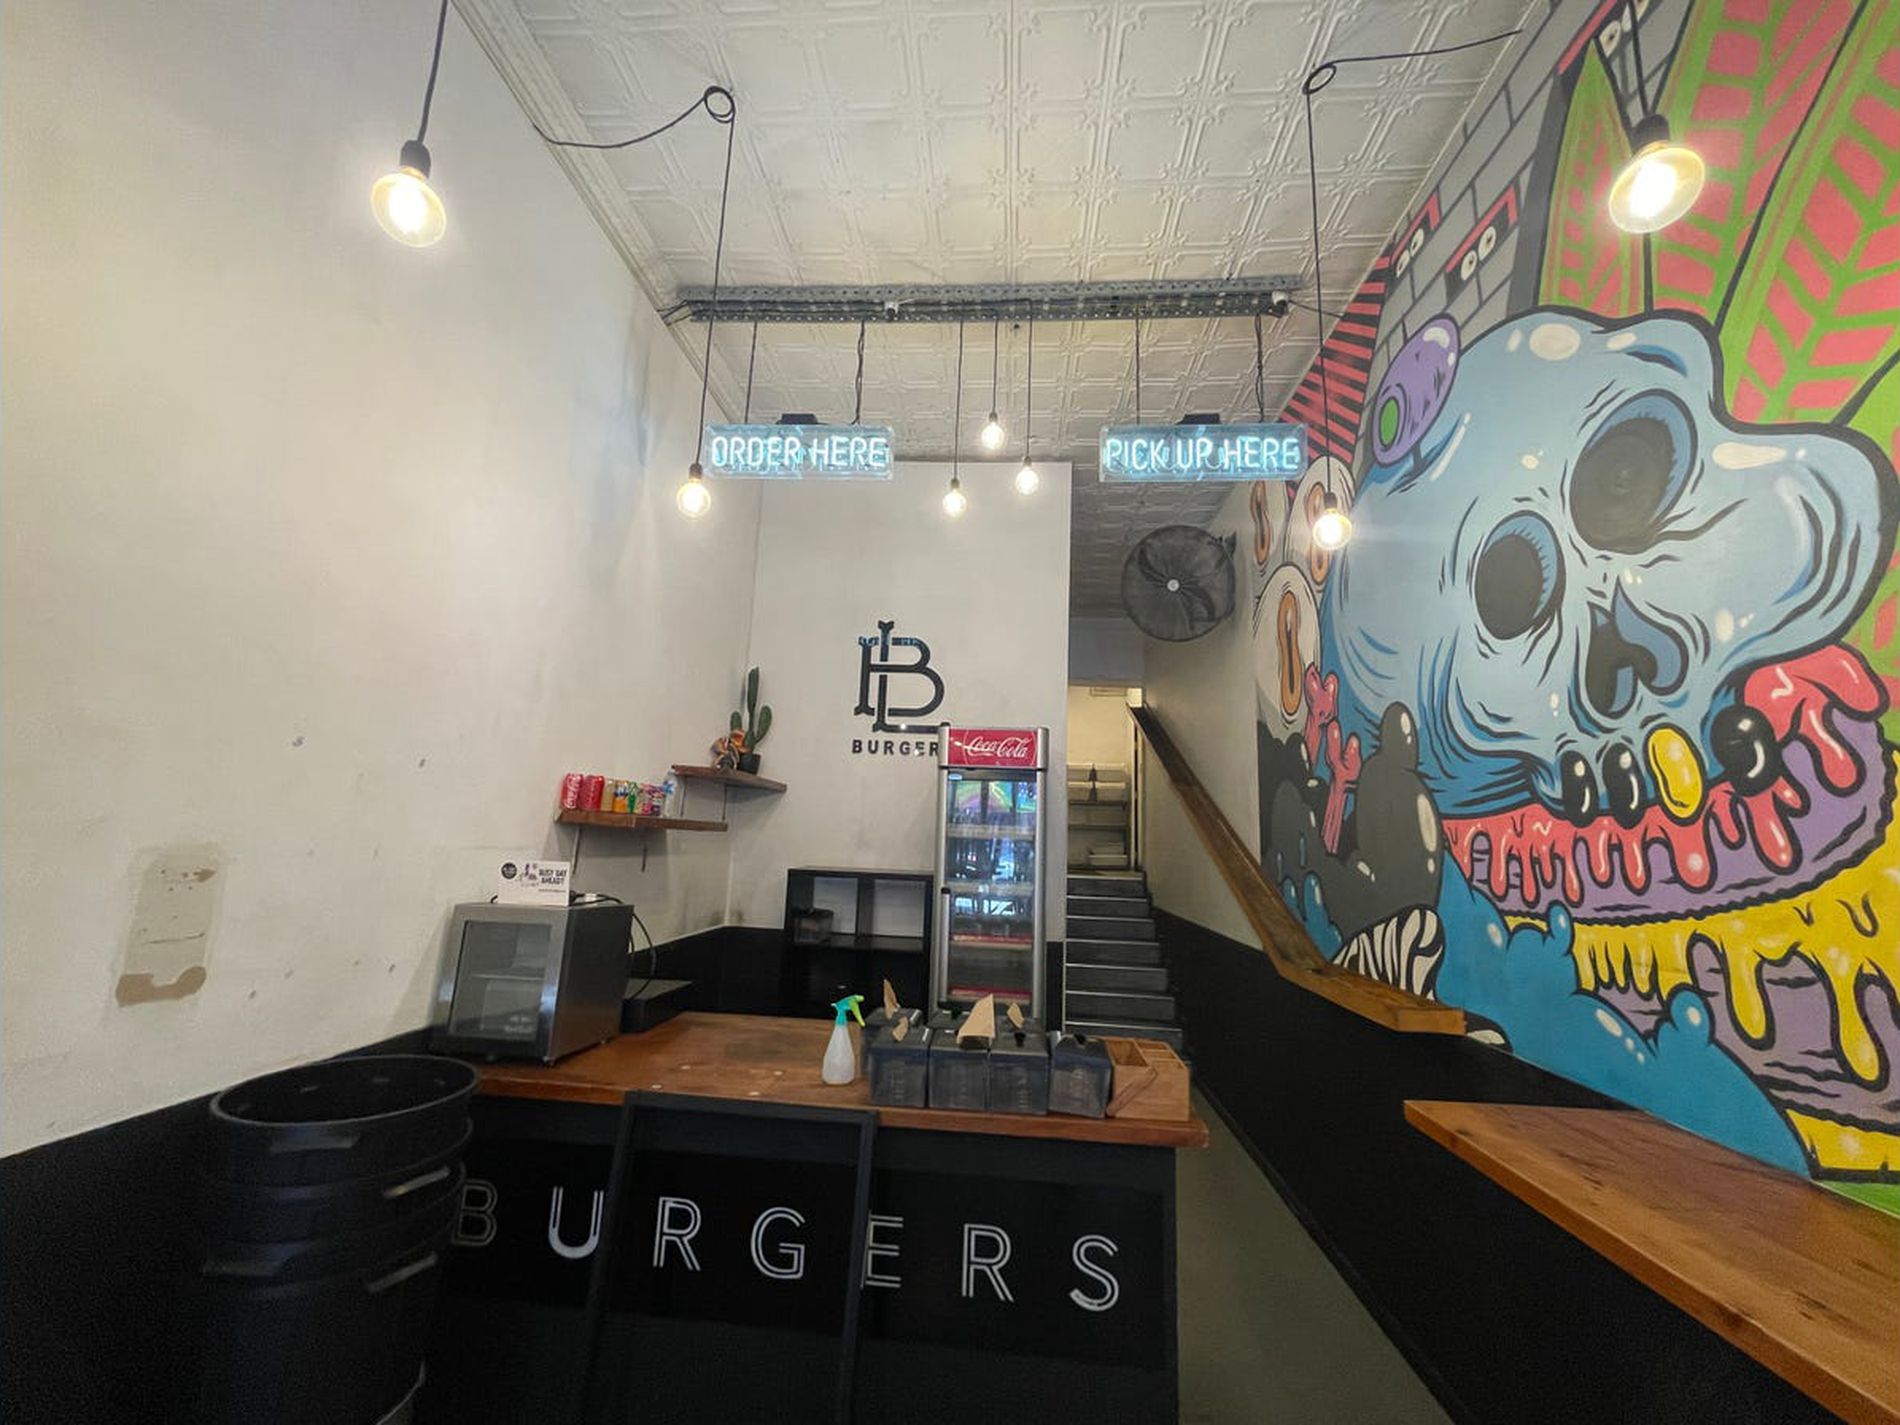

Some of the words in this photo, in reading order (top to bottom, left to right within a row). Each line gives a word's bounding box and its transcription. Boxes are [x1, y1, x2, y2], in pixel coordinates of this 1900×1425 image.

[711, 436, 801, 467] ORDER
[809, 435, 889, 468] HERE
[1104, 437, 1168, 471] PICK
[1176, 437, 1214, 470] UP
[1222, 435, 1301, 470] HERE
[450, 1178, 1121, 1313] BURGERS
